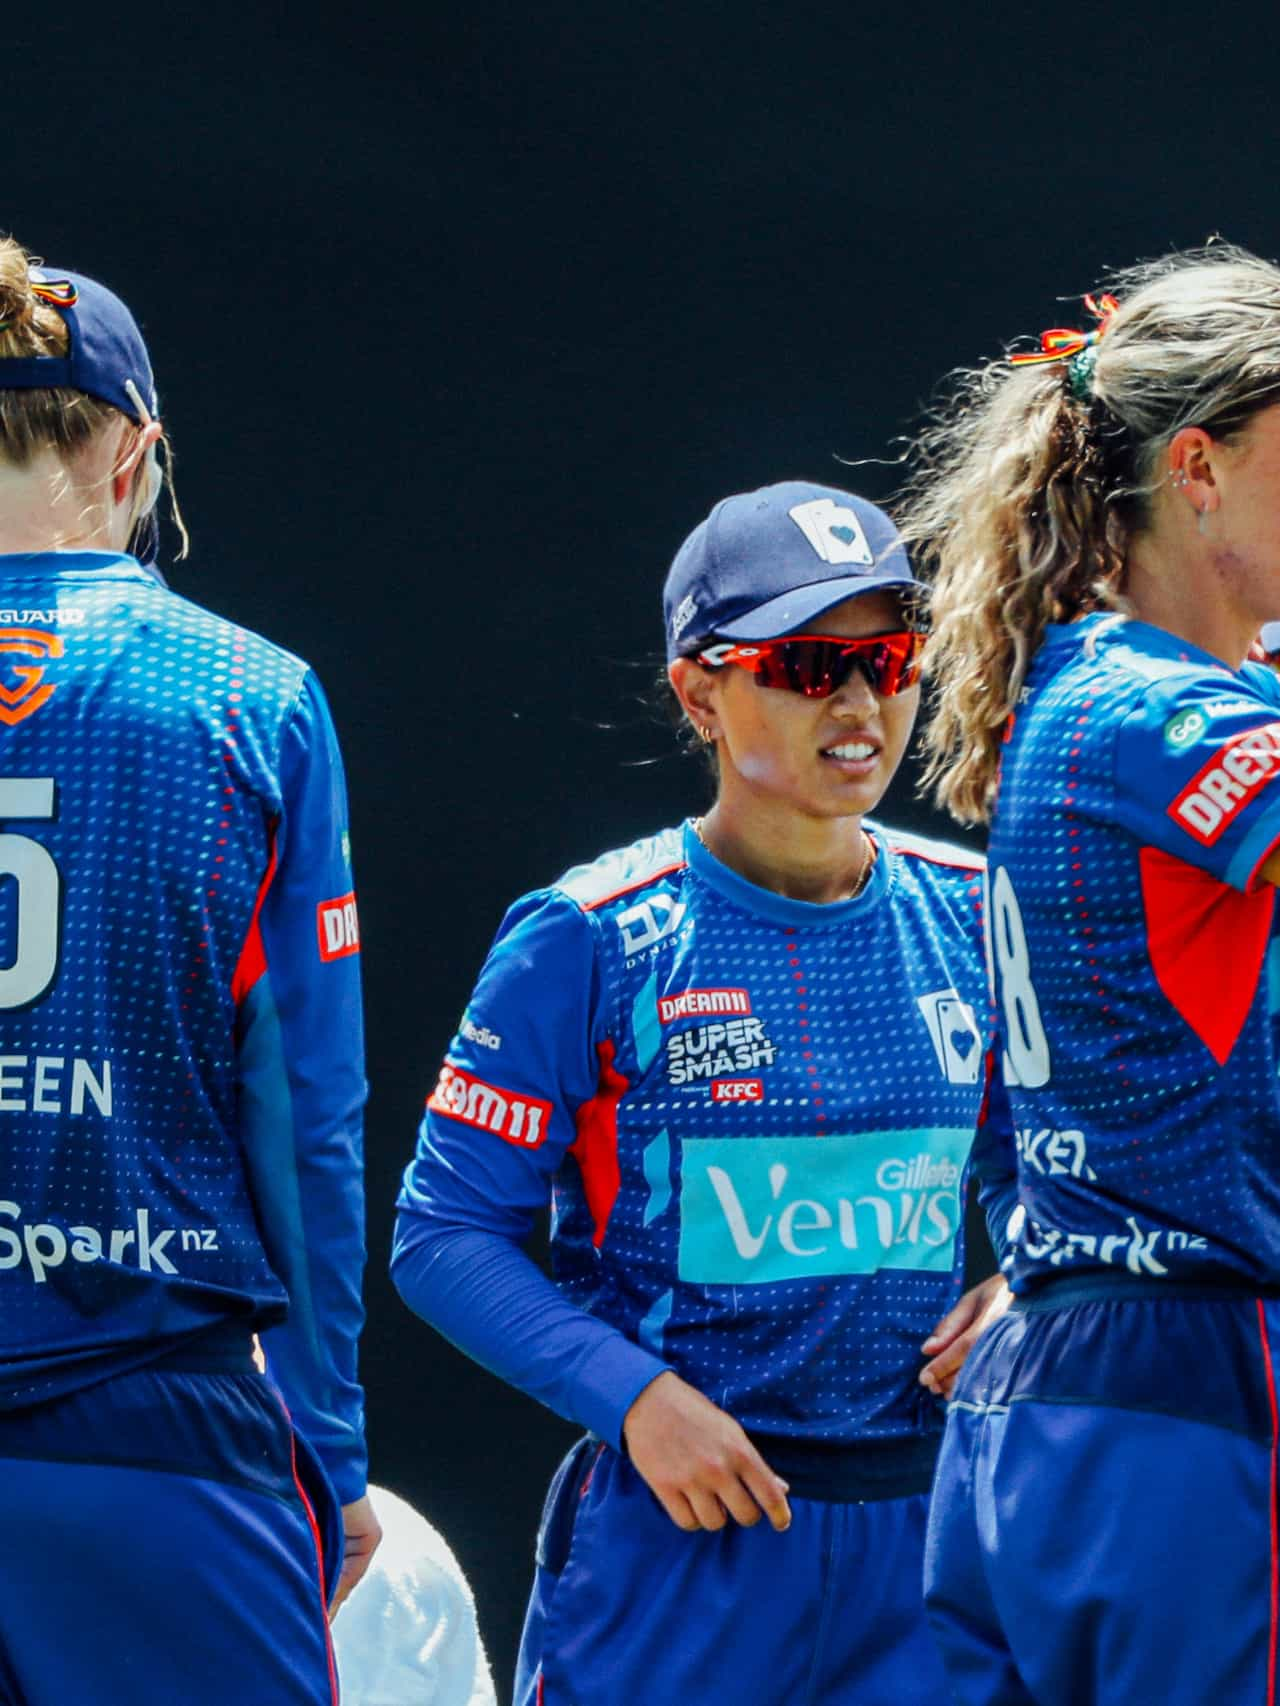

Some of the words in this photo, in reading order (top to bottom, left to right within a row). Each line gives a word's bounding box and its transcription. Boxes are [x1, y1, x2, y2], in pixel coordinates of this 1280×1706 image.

[1168, 714, 1204, 743] GO
[983, 864, 1050, 1089] 8
[666, 1017, 766, 1060] SUPER
[666, 1040, 777, 1085] SMASH
[715, 1083, 758, 1099] KFC
[0, 1200, 179, 1284] Spark
